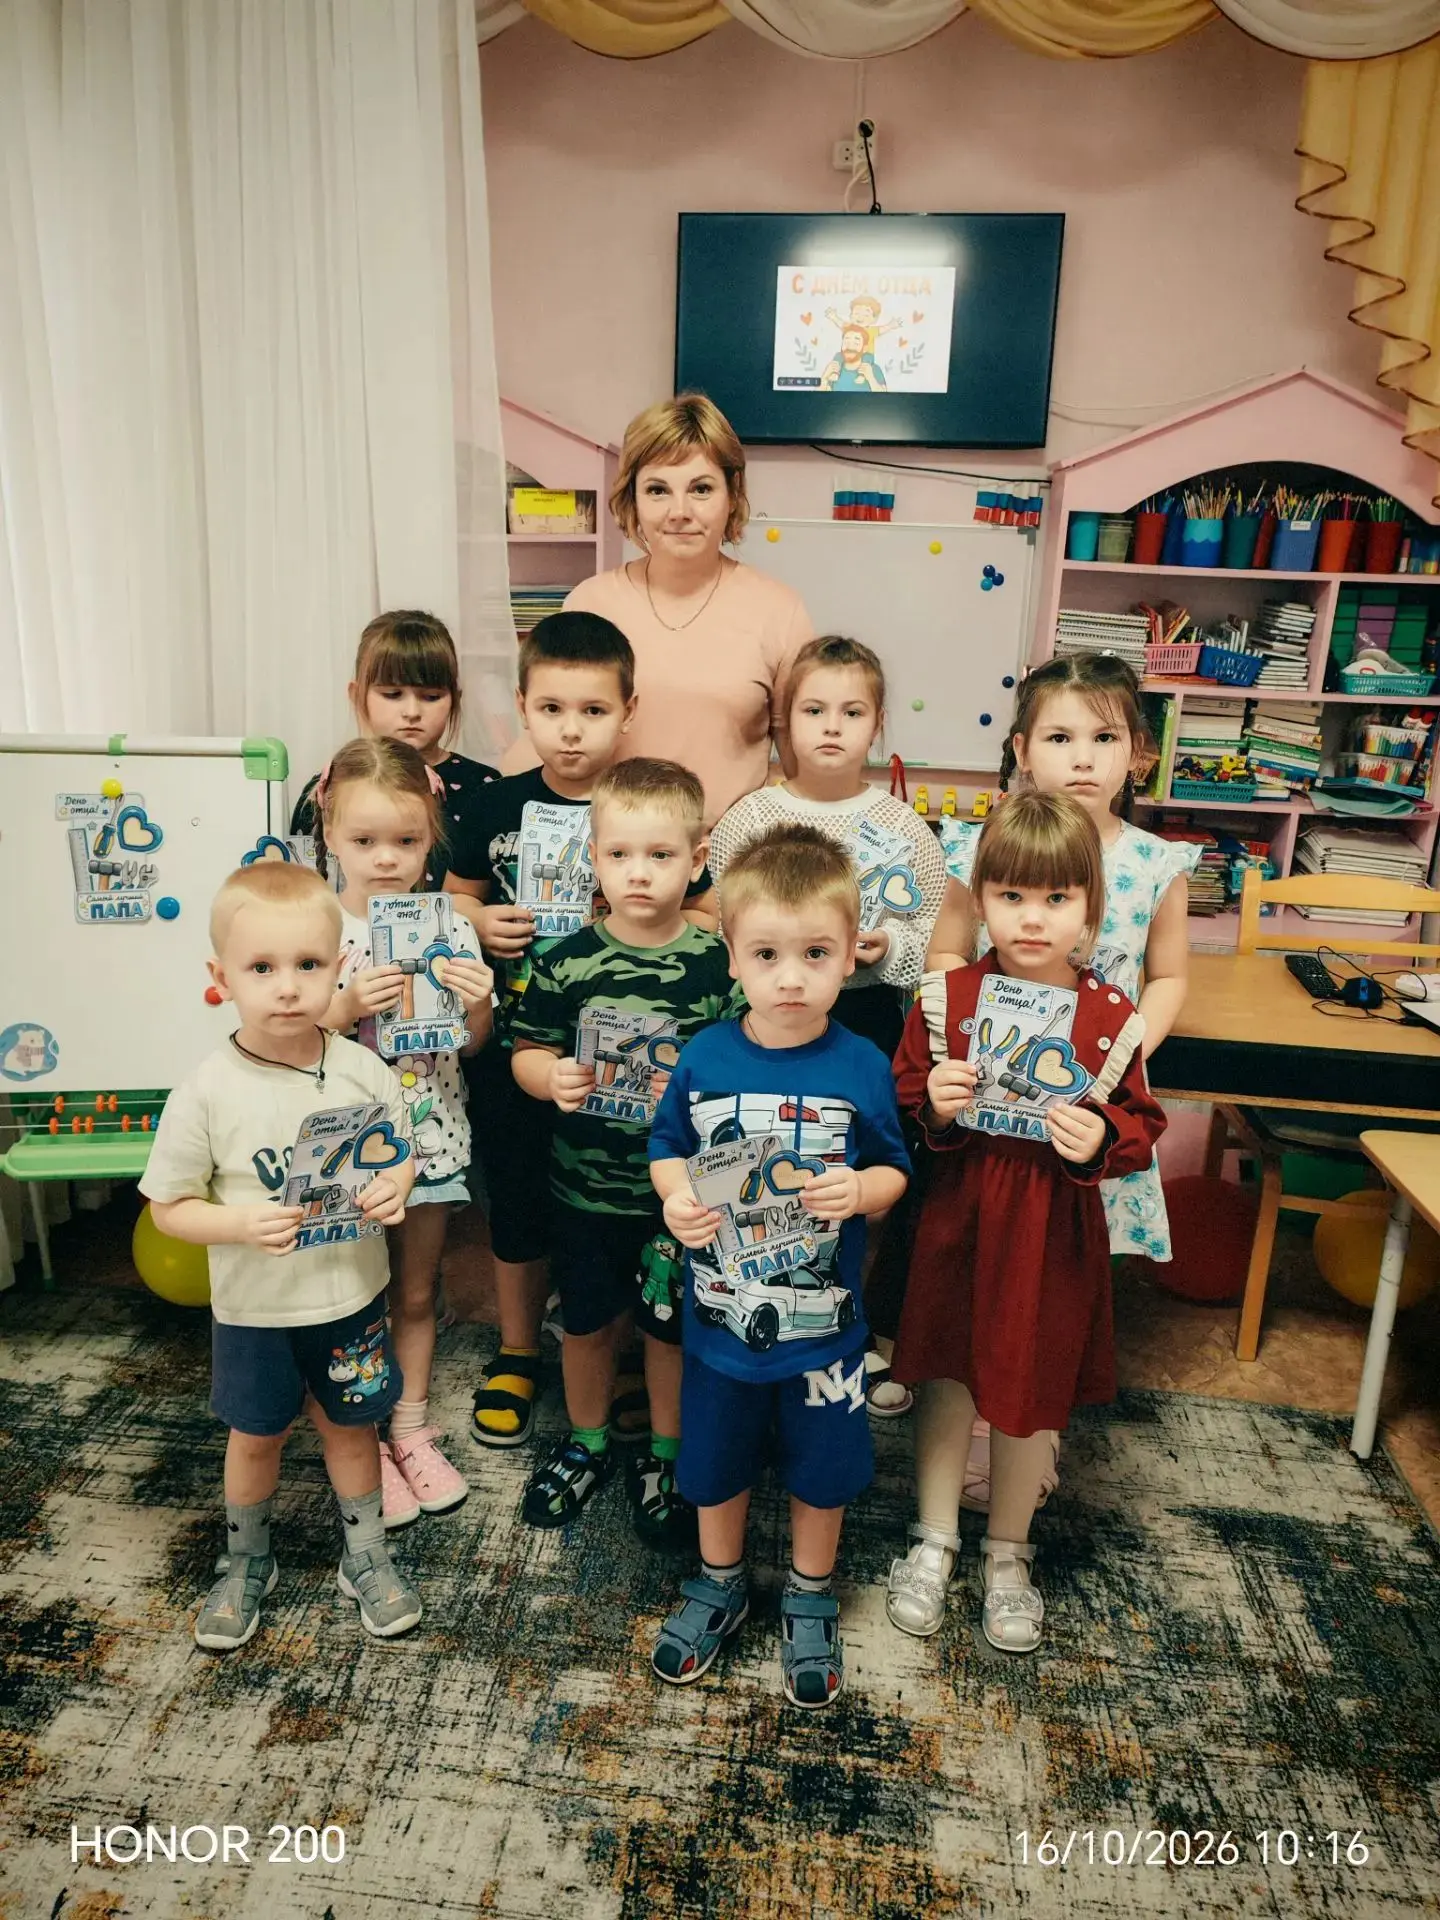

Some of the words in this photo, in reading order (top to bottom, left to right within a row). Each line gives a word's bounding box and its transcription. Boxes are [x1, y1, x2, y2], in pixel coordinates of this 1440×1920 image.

[792, 274, 805, 294] С
[70, 803, 99, 815] отца!
[534, 805, 557, 816] День
[538, 815, 568, 827] отца!
[859, 821, 878, 836] День
[859, 832, 886, 848] отца!
[90, 902, 143, 919] ПАПА
[383, 898, 416, 913] отца!
[993, 980, 1023, 994] День
[998, 996, 1036, 1010] отца!
[590, 1010, 618, 1021] День
[390, 1024, 420, 1035] Самый
[422, 1021, 454, 1034] лучший
[596, 1020, 631, 1030] отца!
[394, 1030, 454, 1052] ПАПА
[586, 1095, 646, 1120] ПАПА
[976, 1100, 1010, 1113] Самый
[310, 1116, 338, 1128] День
[313, 1120, 350, 1136] отца!
[977, 1110, 1044, 1138] ПАПА
[697, 1150, 726, 1167] День
[706, 1150, 743, 1173] отца!
[327, 1212, 363, 1225] лучший
[295, 1223, 358, 1248] ПАПА
[732, 1244, 768, 1264] Самый
[768, 1233, 806, 1252] лучший
[738, 1243, 811, 1282] ПАПА
